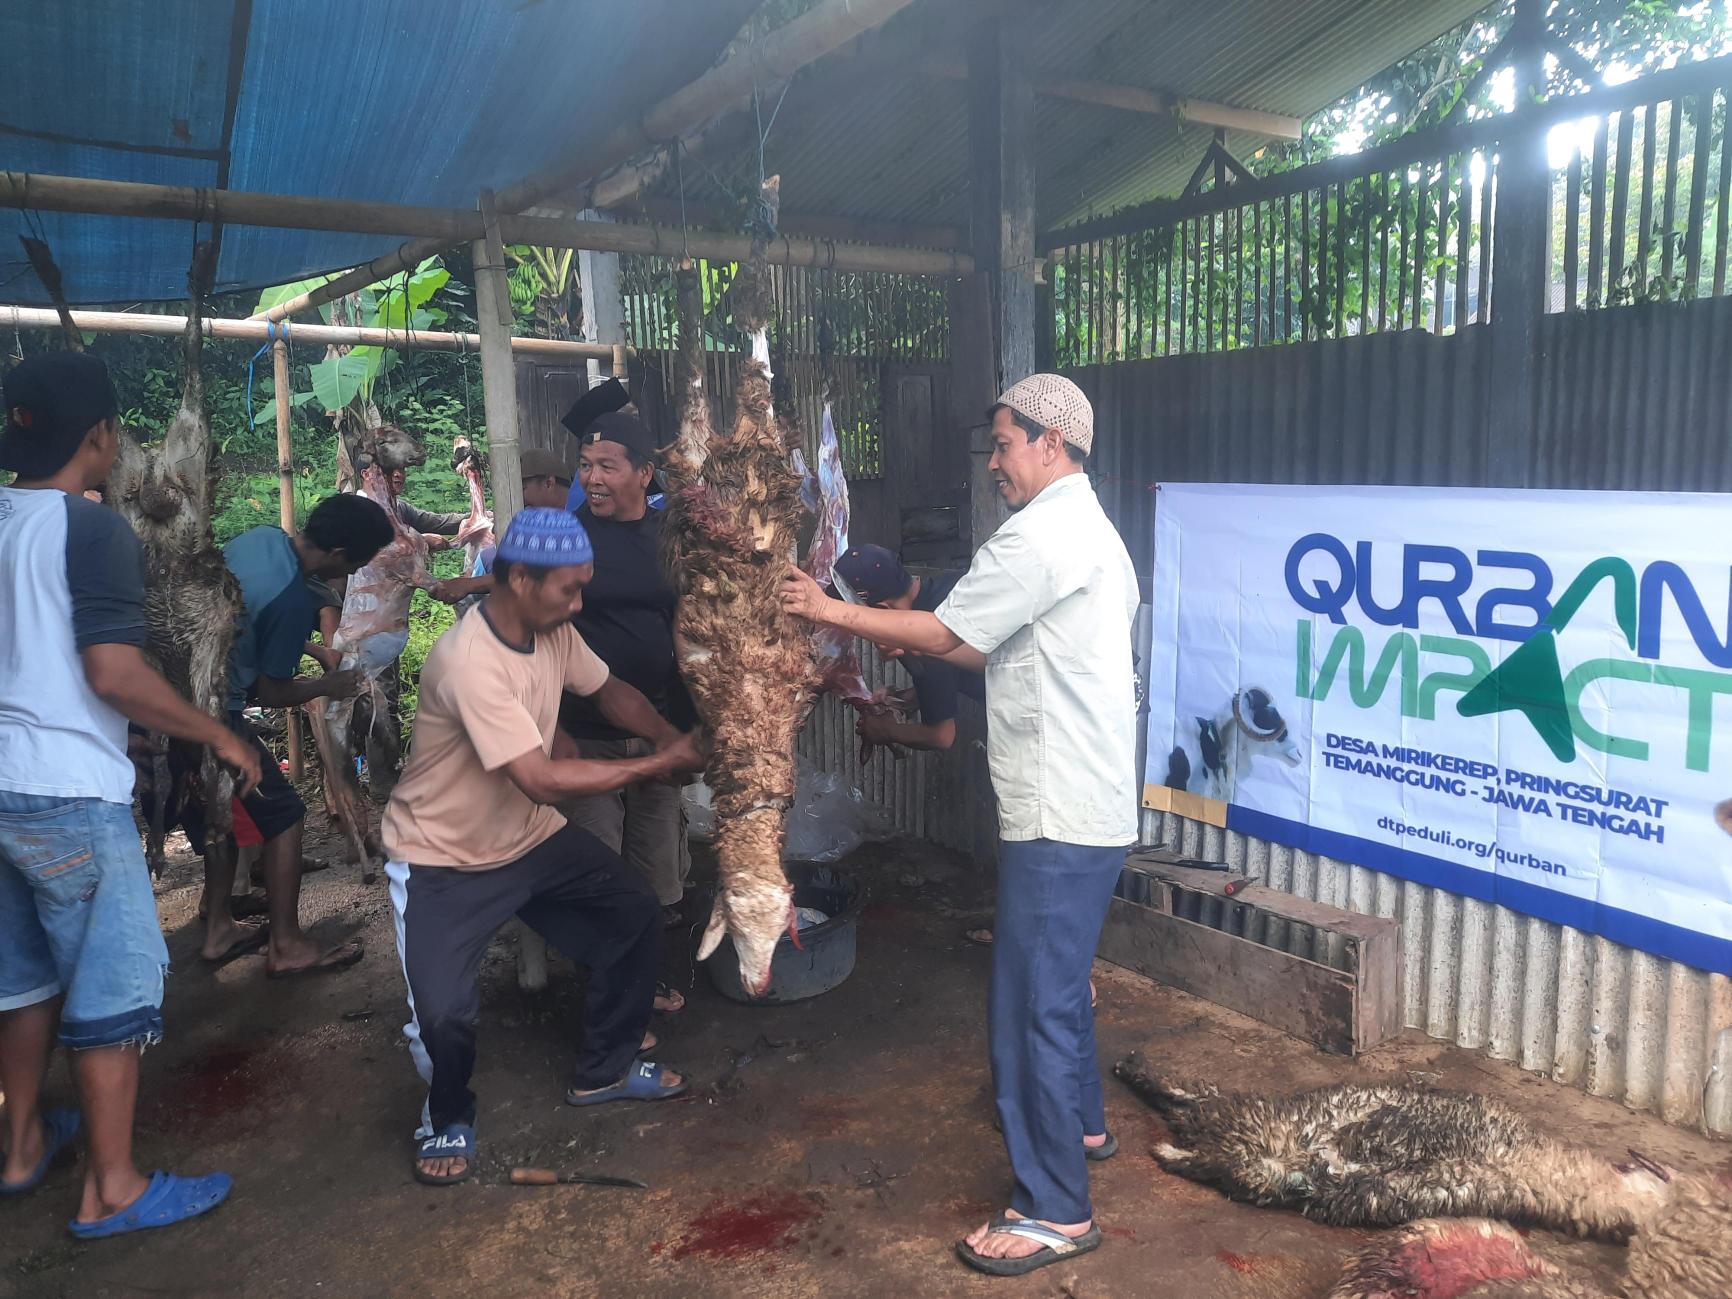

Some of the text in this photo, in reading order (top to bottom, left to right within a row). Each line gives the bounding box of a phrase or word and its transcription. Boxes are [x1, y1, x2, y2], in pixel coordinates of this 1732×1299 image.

[1284, 533, 1732, 668] QURBAN
[1296, 619, 1732, 772] IMPACT
[1322, 751, 1467, 797] TEMANGGUNG
[1481, 785, 1553, 818] JAWA
[1555, 801, 1665, 844] TENGAH
[1326, 733, 1669, 818] DESA MIRIKEREP, PRINGSURAT
[1377, 816, 1567, 877] dtpeduli.org/qurban
[422, 1134, 467, 1151] FILA
